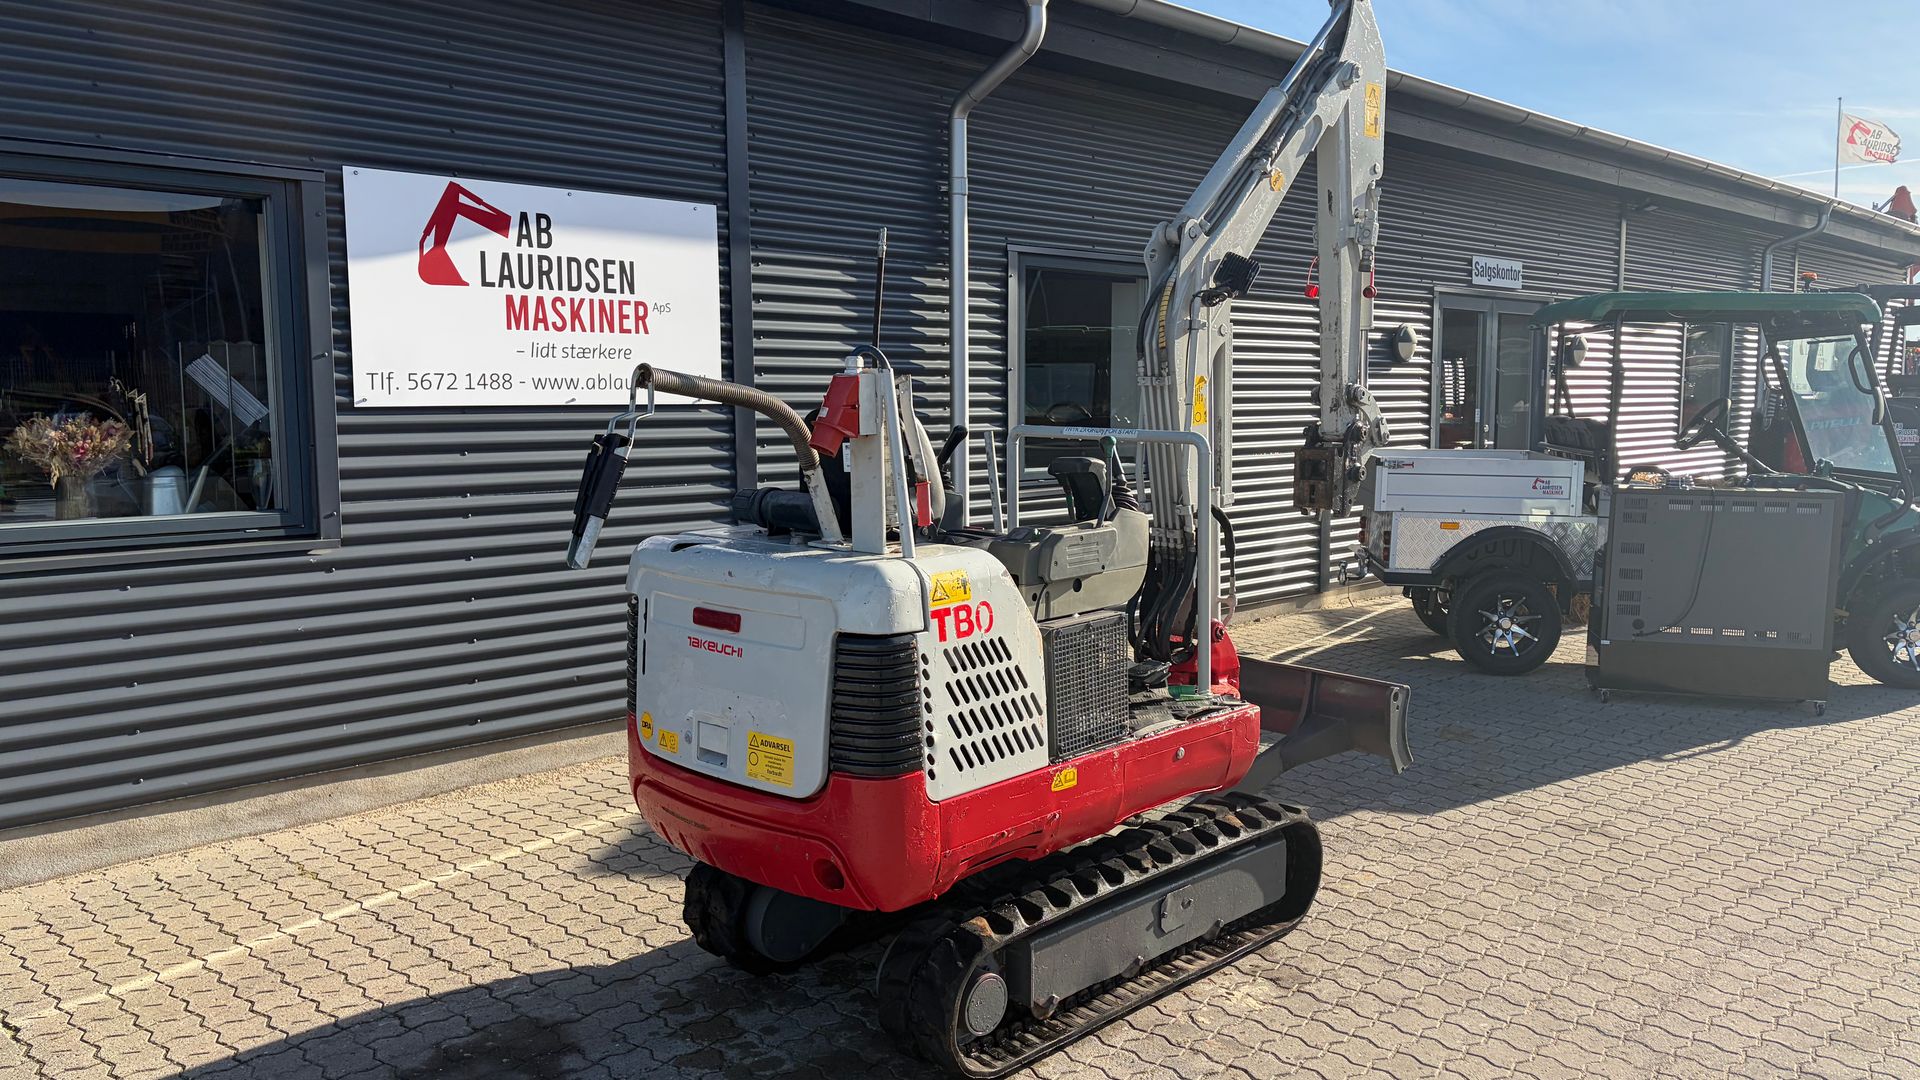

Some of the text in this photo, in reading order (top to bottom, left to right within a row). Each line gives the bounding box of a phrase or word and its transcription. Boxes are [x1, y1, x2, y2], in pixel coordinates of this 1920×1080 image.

[1870, 129, 1882, 140] AB
[1861, 138, 1896, 155] LAURIDSE
[516, 211, 552, 249] AB
[480, 250, 636, 295] LAURIDSEN
[1474, 260, 1521, 282] Salgskontor
[505, 294, 672, 335] MASKINER ApS
[531, 341, 557, 359] lidt
[561, 343, 632, 360] stærkere
[366, 371, 400, 395] Tlf.
[408, 372, 458, 391] 5672
[464, 372, 513, 391] 1488
[532, 373, 632, 391] www.ablau
[641, 720, 652, 730] DRA
[759, 739, 791, 752] ADVARSEL
